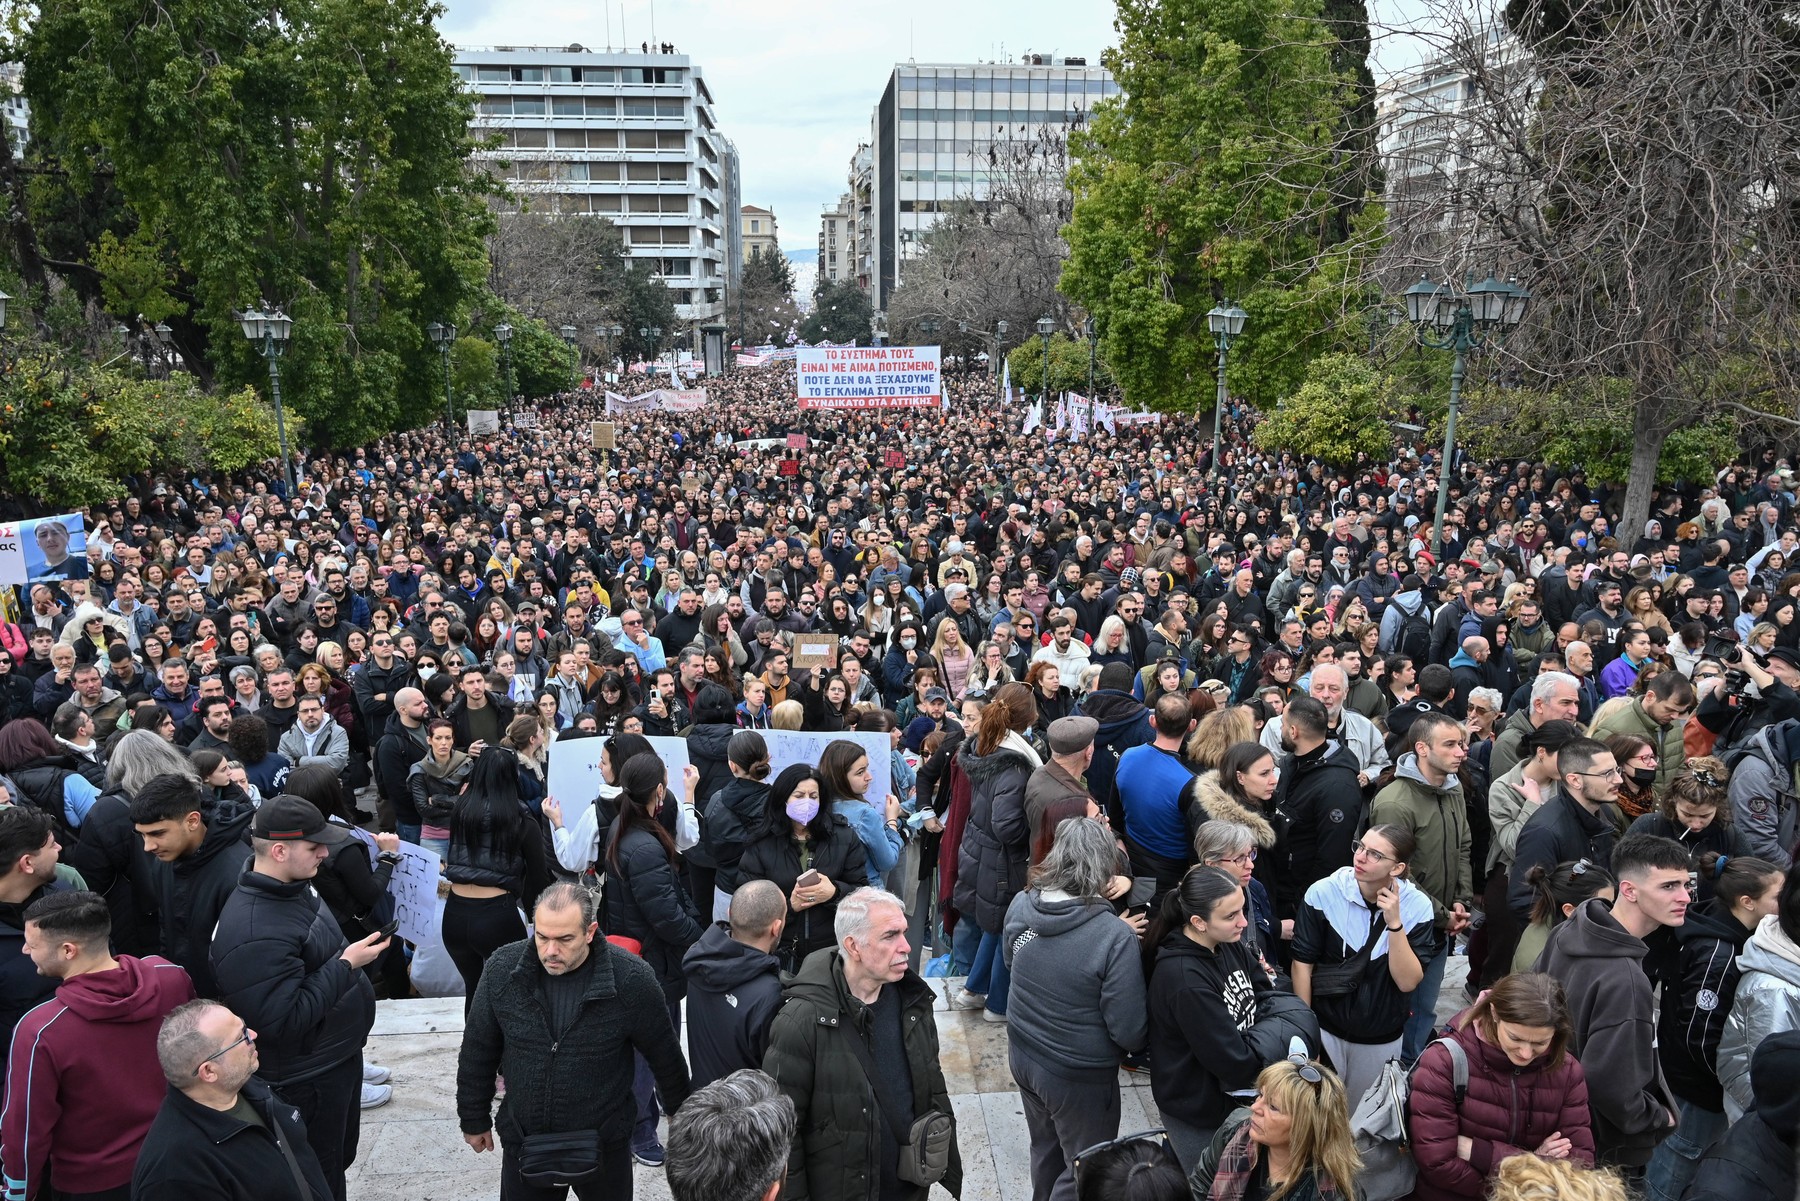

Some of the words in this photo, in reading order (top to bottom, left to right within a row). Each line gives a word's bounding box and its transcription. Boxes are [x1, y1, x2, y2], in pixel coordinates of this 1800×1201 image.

[825, 350, 838, 360] ΤΟ
[840, 349, 887, 360] ΣΥΣΤΗΜΑ
[890, 348, 914, 359] ΤΟΥΣ
[801, 363, 829, 373] ΕΙΝΑΙ
[831, 362, 847, 372] ΜΕ
[849, 362, 876, 372] ΑΙΜΑ
[878, 361, 938, 372] ΠΟΤΙΣΜΕΝΟ,
[804, 375, 831, 385] ΠΟΤΕ
[833, 375, 855, 385] ΔΕΝ
[857, 375, 872, 384] ΘΑ
[875, 374, 935, 384] ΞΕΧΑΣΟΥΜΕ
[808, 387, 821, 397] ΤΟ
[824, 387, 875, 396] ΕΓΚΛΗΜΑ
[877, 386, 896, 395] ΣΤΟ
[898, 385, 931, 395] ΤΡΕΝΟ
[807, 398, 866, 407] ΣΥΝΔΙΚΑΤΟ
[868, 398, 888, 407] ΟΤΑ
[890, 397, 932, 406] ΑΤΤΙΚΗΣ
